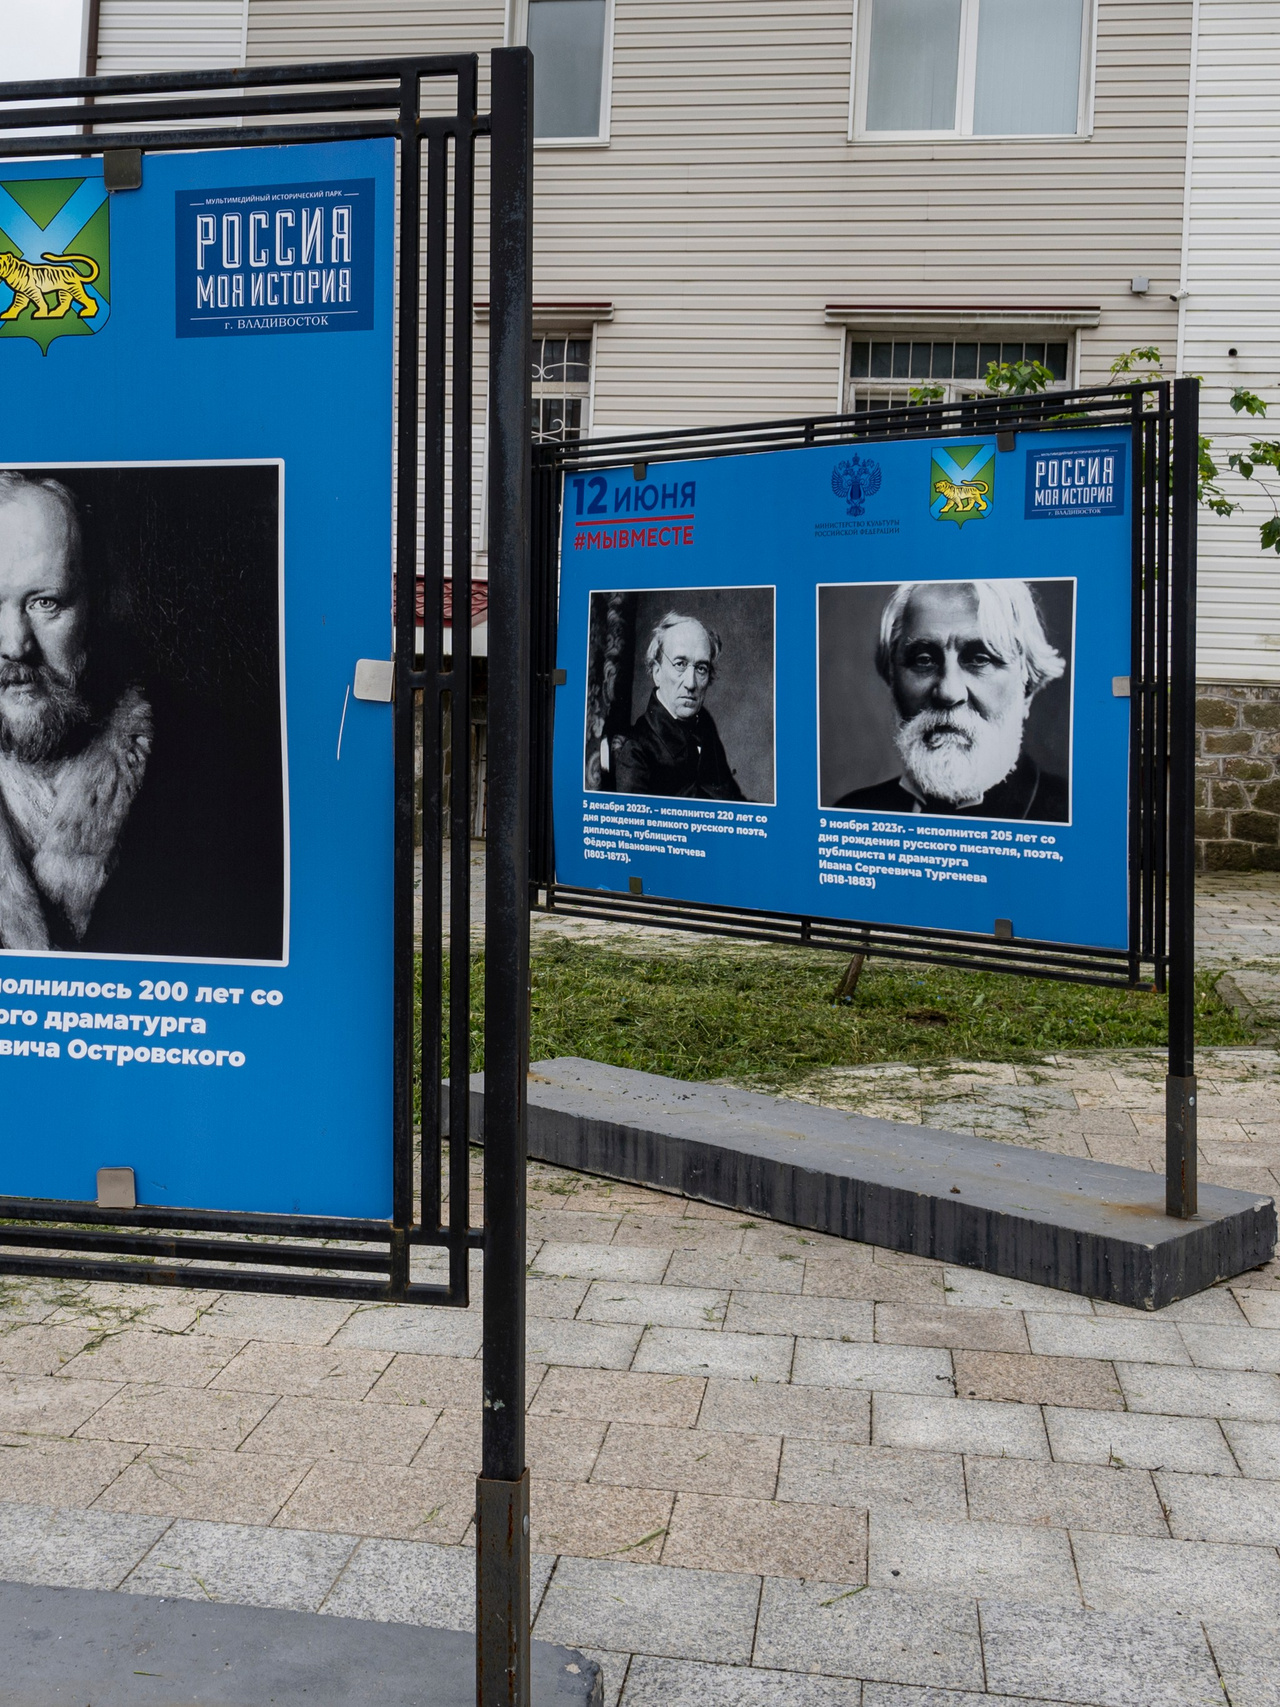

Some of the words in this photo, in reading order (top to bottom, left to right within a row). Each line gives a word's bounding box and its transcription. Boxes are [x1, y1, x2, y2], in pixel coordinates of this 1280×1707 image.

[205, 194, 271, 206] МУЛЬТИМЕДИЙНЫЙ
[271, 191, 324, 201] ИСТОРИЧЕСКИЙ
[325, 190, 343, 198] ПАРК
[196, 204, 352, 271] РОССИЯ
[196, 272, 245, 310] МОЯ
[250, 267, 352, 307] ИСТОРИЯ
[224, 321, 234, 331] г.
[237, 315, 329, 331] ВЛАДИВОСТОК
[1035, 455, 1115, 488] РОССИЯ
[572, 476, 608, 516] 12
[614, 481, 696, 513] ИЮНЯ
[1035, 489, 1059, 506] МОЯ
[1061, 486, 1113, 504] ИСТОРИЯ
[1054, 508, 1101, 516] ВЛАДИВОСТОК
[814, 521, 866, 530] МИНИСТЕРСТВО
[866, 519, 900, 527] КУЛЬТУРЫ
[814, 528, 858, 538] РОССИЙСКОЙ
[859, 527, 900, 536] ФЕДЕРАЦИИ
[574, 525, 694, 551] #МЫВМЕСТЕ
[582, 799, 588, 808] 5
[588, 801, 625, 812] декабря
[626, 803, 653, 813] 2023г.
[660, 807, 716, 818] исполнится
[716, 810, 735, 820] 220
[735, 813, 754, 821] лет
[755, 815, 768, 823] со
[582, 813, 599, 821] дня
[600, 815, 645, 825] рождения
[646, 819, 689, 829] великого
[690, 823, 735, 833] русского
[736, 826, 768, 838] поэта,
[582, 825, 633, 838] дипломата,
[633, 829, 688, 842] публициста
[819, 817, 827, 827] 9
[829, 819, 870, 832] ноября
[871, 821, 906, 833] 2023г.
[916, 826, 988, 839] исполнится
[990, 829, 1013, 841] 205
[1015, 833, 1038, 842] лет
[1040, 835, 1056, 844] со
[583, 836, 617, 849] Фёдора
[617, 840, 666, 853] Ивановича
[666, 845, 706, 857] Тютчева
[583, 848, 632, 863] (1803-1873).
[817, 833, 839, 842] дня
[841, 835, 901, 847] рождения
[902, 839, 958, 851] русского
[959, 844, 1021, 858] писателя,
[1023, 849, 1064, 861] поэта,
[818, 845, 886, 860] публициста
[887, 852, 896, 860] и
[898, 853, 969, 867] драматурга
[818, 859, 853, 871] Ивана
[854, 862, 923, 877] Сергеевича
[924, 868, 988, 883] Тургенева
[818, 872, 876, 889] (1818-1883)
[138, 980, 189, 1002] 200
[194, 986, 245, 1004] лет
[250, 989, 284, 1006] со
[43, 1011, 207, 1037] драматурга
[67, 1038, 246, 1067] Островского
